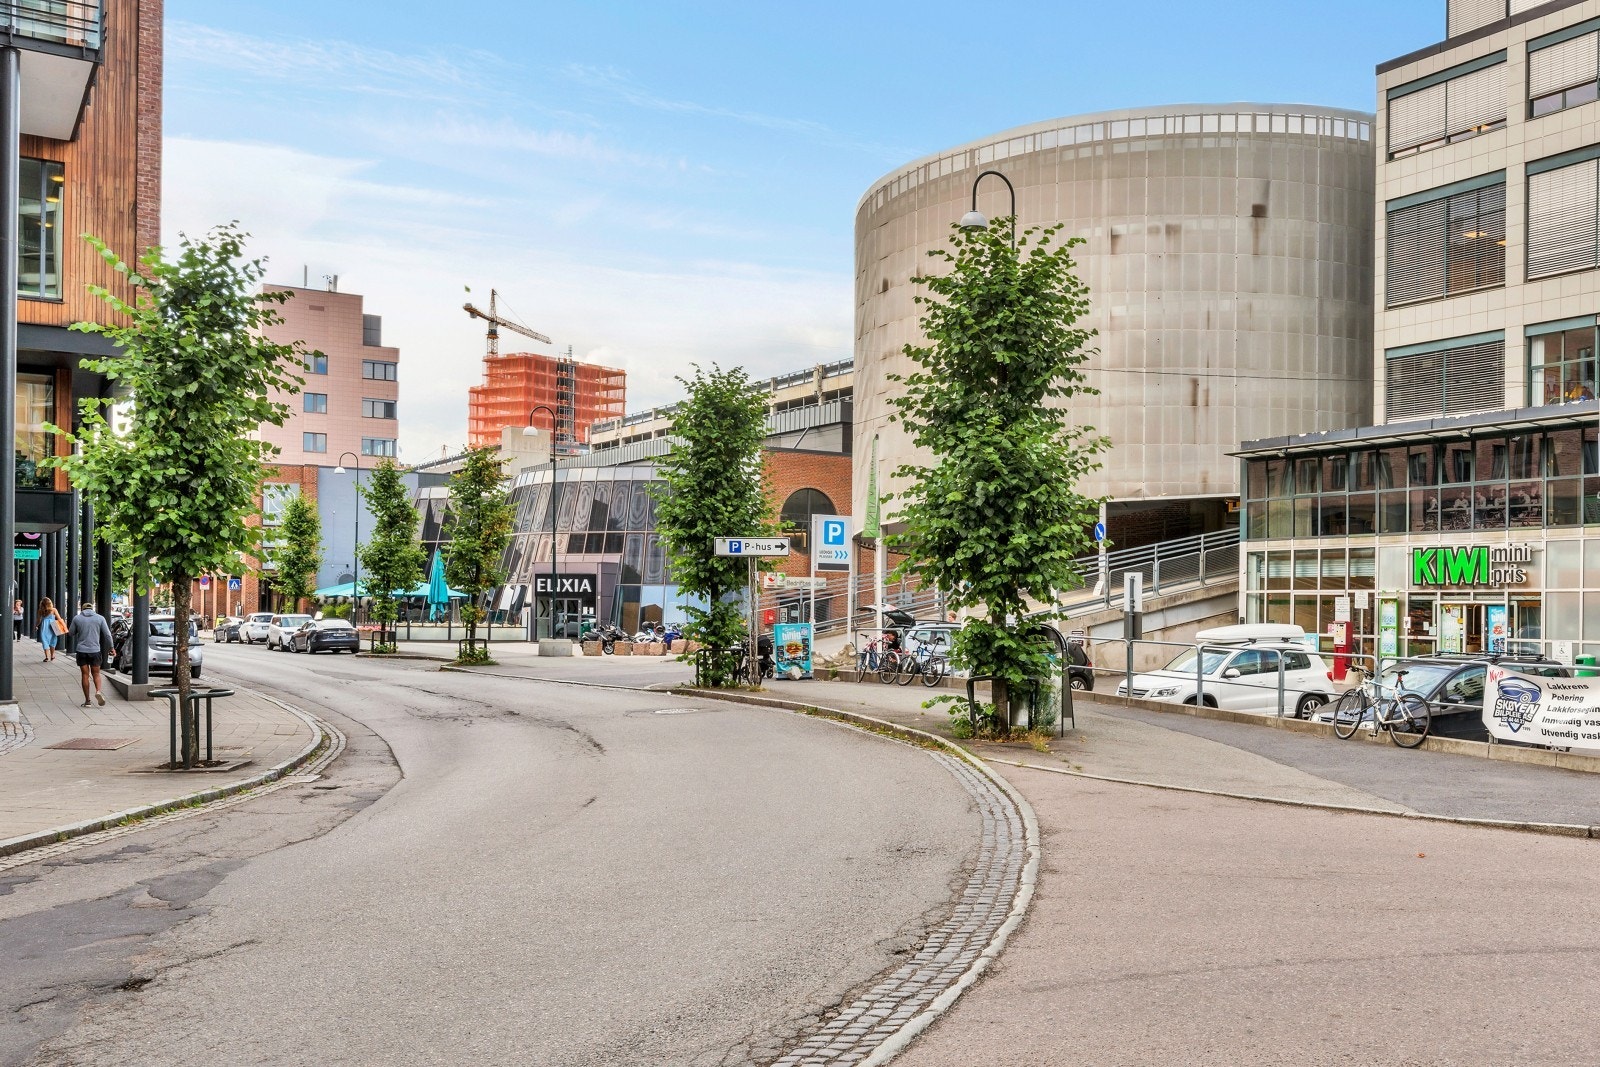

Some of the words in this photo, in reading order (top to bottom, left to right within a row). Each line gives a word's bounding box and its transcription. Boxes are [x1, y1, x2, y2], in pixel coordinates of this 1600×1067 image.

[828, 523, 842, 543] P
[744, 542, 772, 551] P-hus
[1492, 543, 1530, 562] mini
[1413, 546, 1490, 586] KIWI
[1492, 564, 1526, 587] pris
[537, 578, 592, 593] ELIXIA
[1546, 682, 1590, 691] Lakkrens
[1551, 693, 1585, 704] Polering
[1495, 699, 1540, 716] SKØYEN
[1495, 710, 1522, 718] BILPLEIE
[1541, 729, 1579, 741] Utvendig
